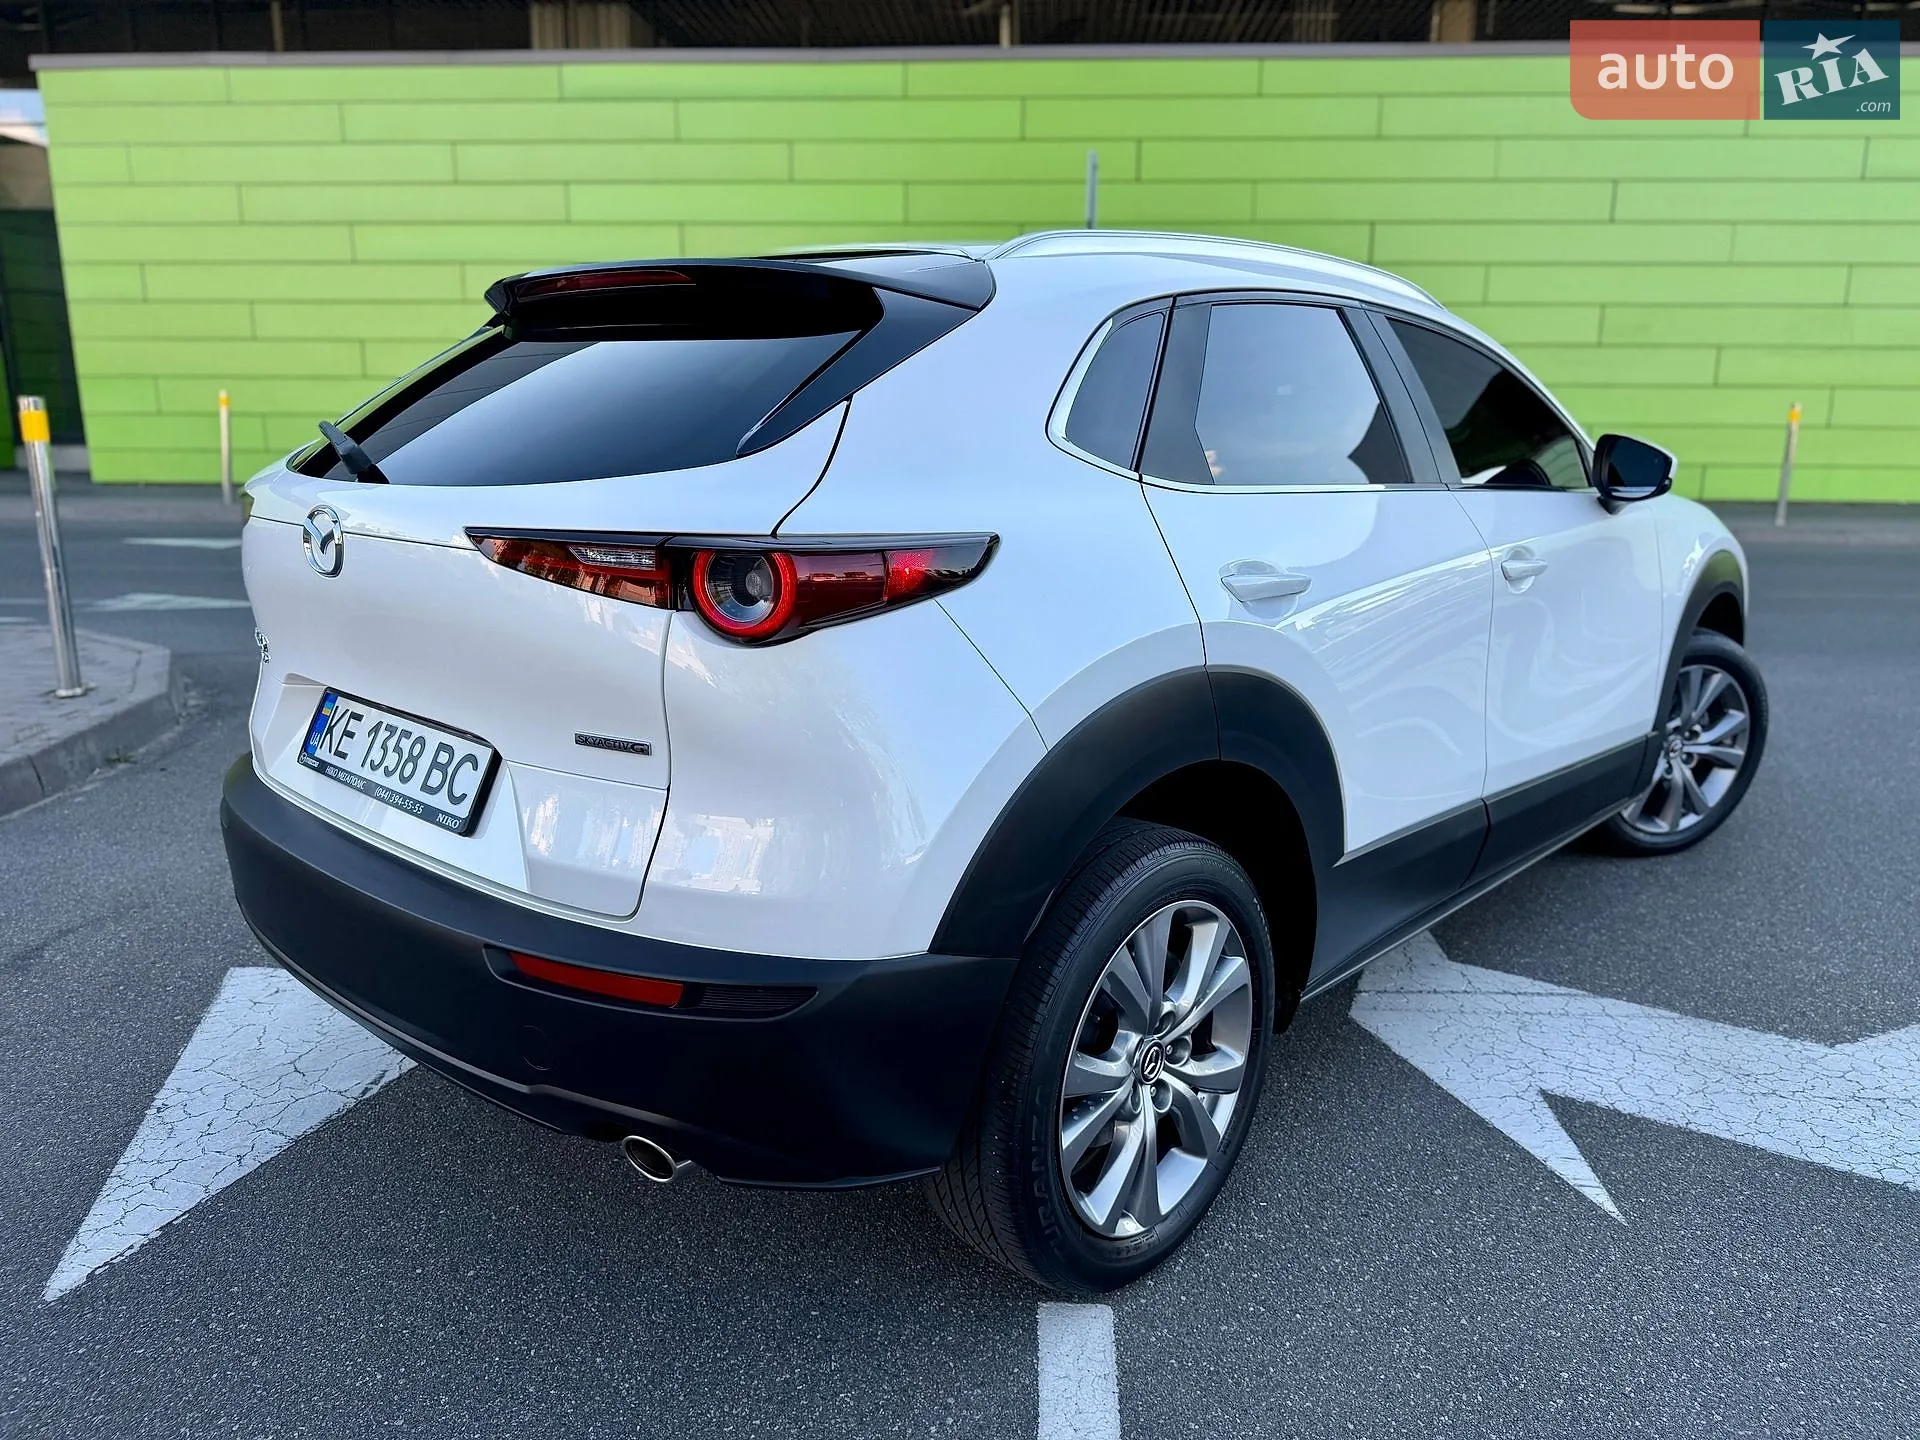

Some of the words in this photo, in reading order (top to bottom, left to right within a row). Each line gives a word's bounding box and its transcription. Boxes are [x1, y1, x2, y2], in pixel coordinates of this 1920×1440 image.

[310, 732, 320, 746] UA
[319, 705, 364, 760] KE
[360, 720, 426, 785] 1358
[419, 741, 479, 806] BC
[374, 786, 391, 801] (044)
[390, 793, 424, 815] 394-55-55
[436, 813, 460, 829] NIKO
